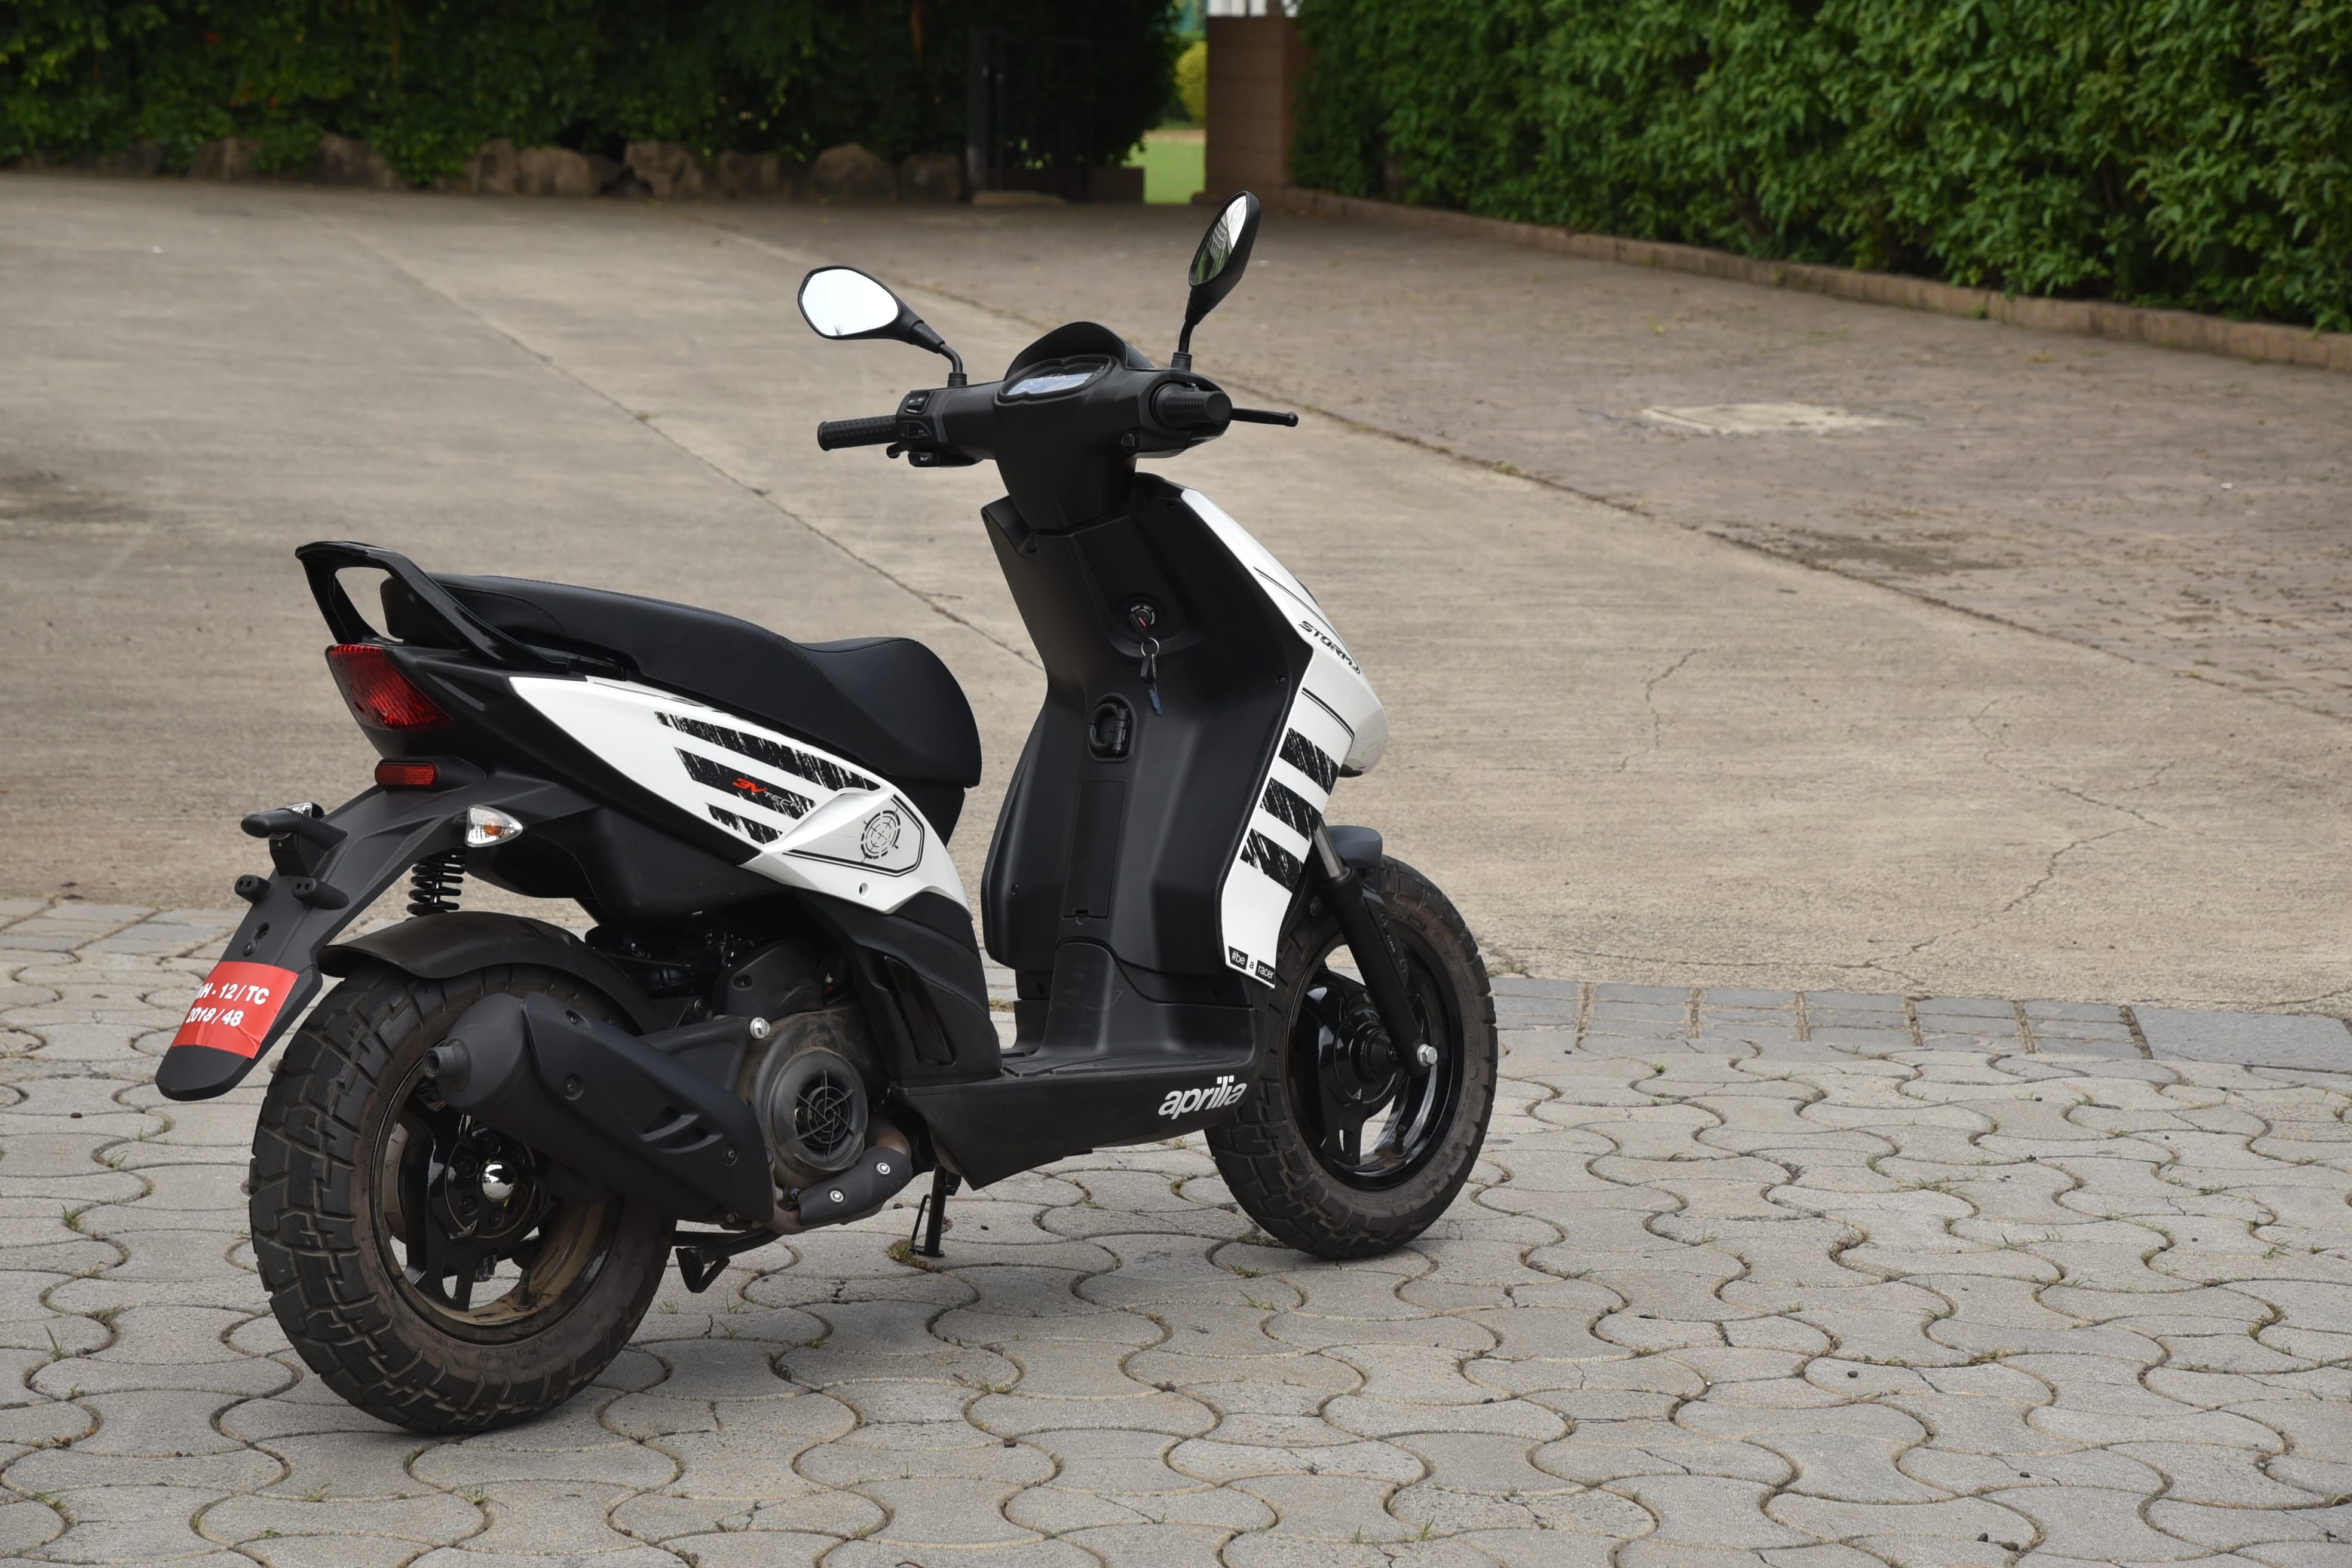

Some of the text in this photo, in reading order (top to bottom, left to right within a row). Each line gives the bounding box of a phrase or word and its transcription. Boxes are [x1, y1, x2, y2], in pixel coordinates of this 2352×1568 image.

[1298, 621, 1353, 666] STORM
[732, 777, 801, 810] 3V TECH
[1231, 951, 1274, 979] #be a racer
[1158, 1075, 1248, 1120] aprilia
